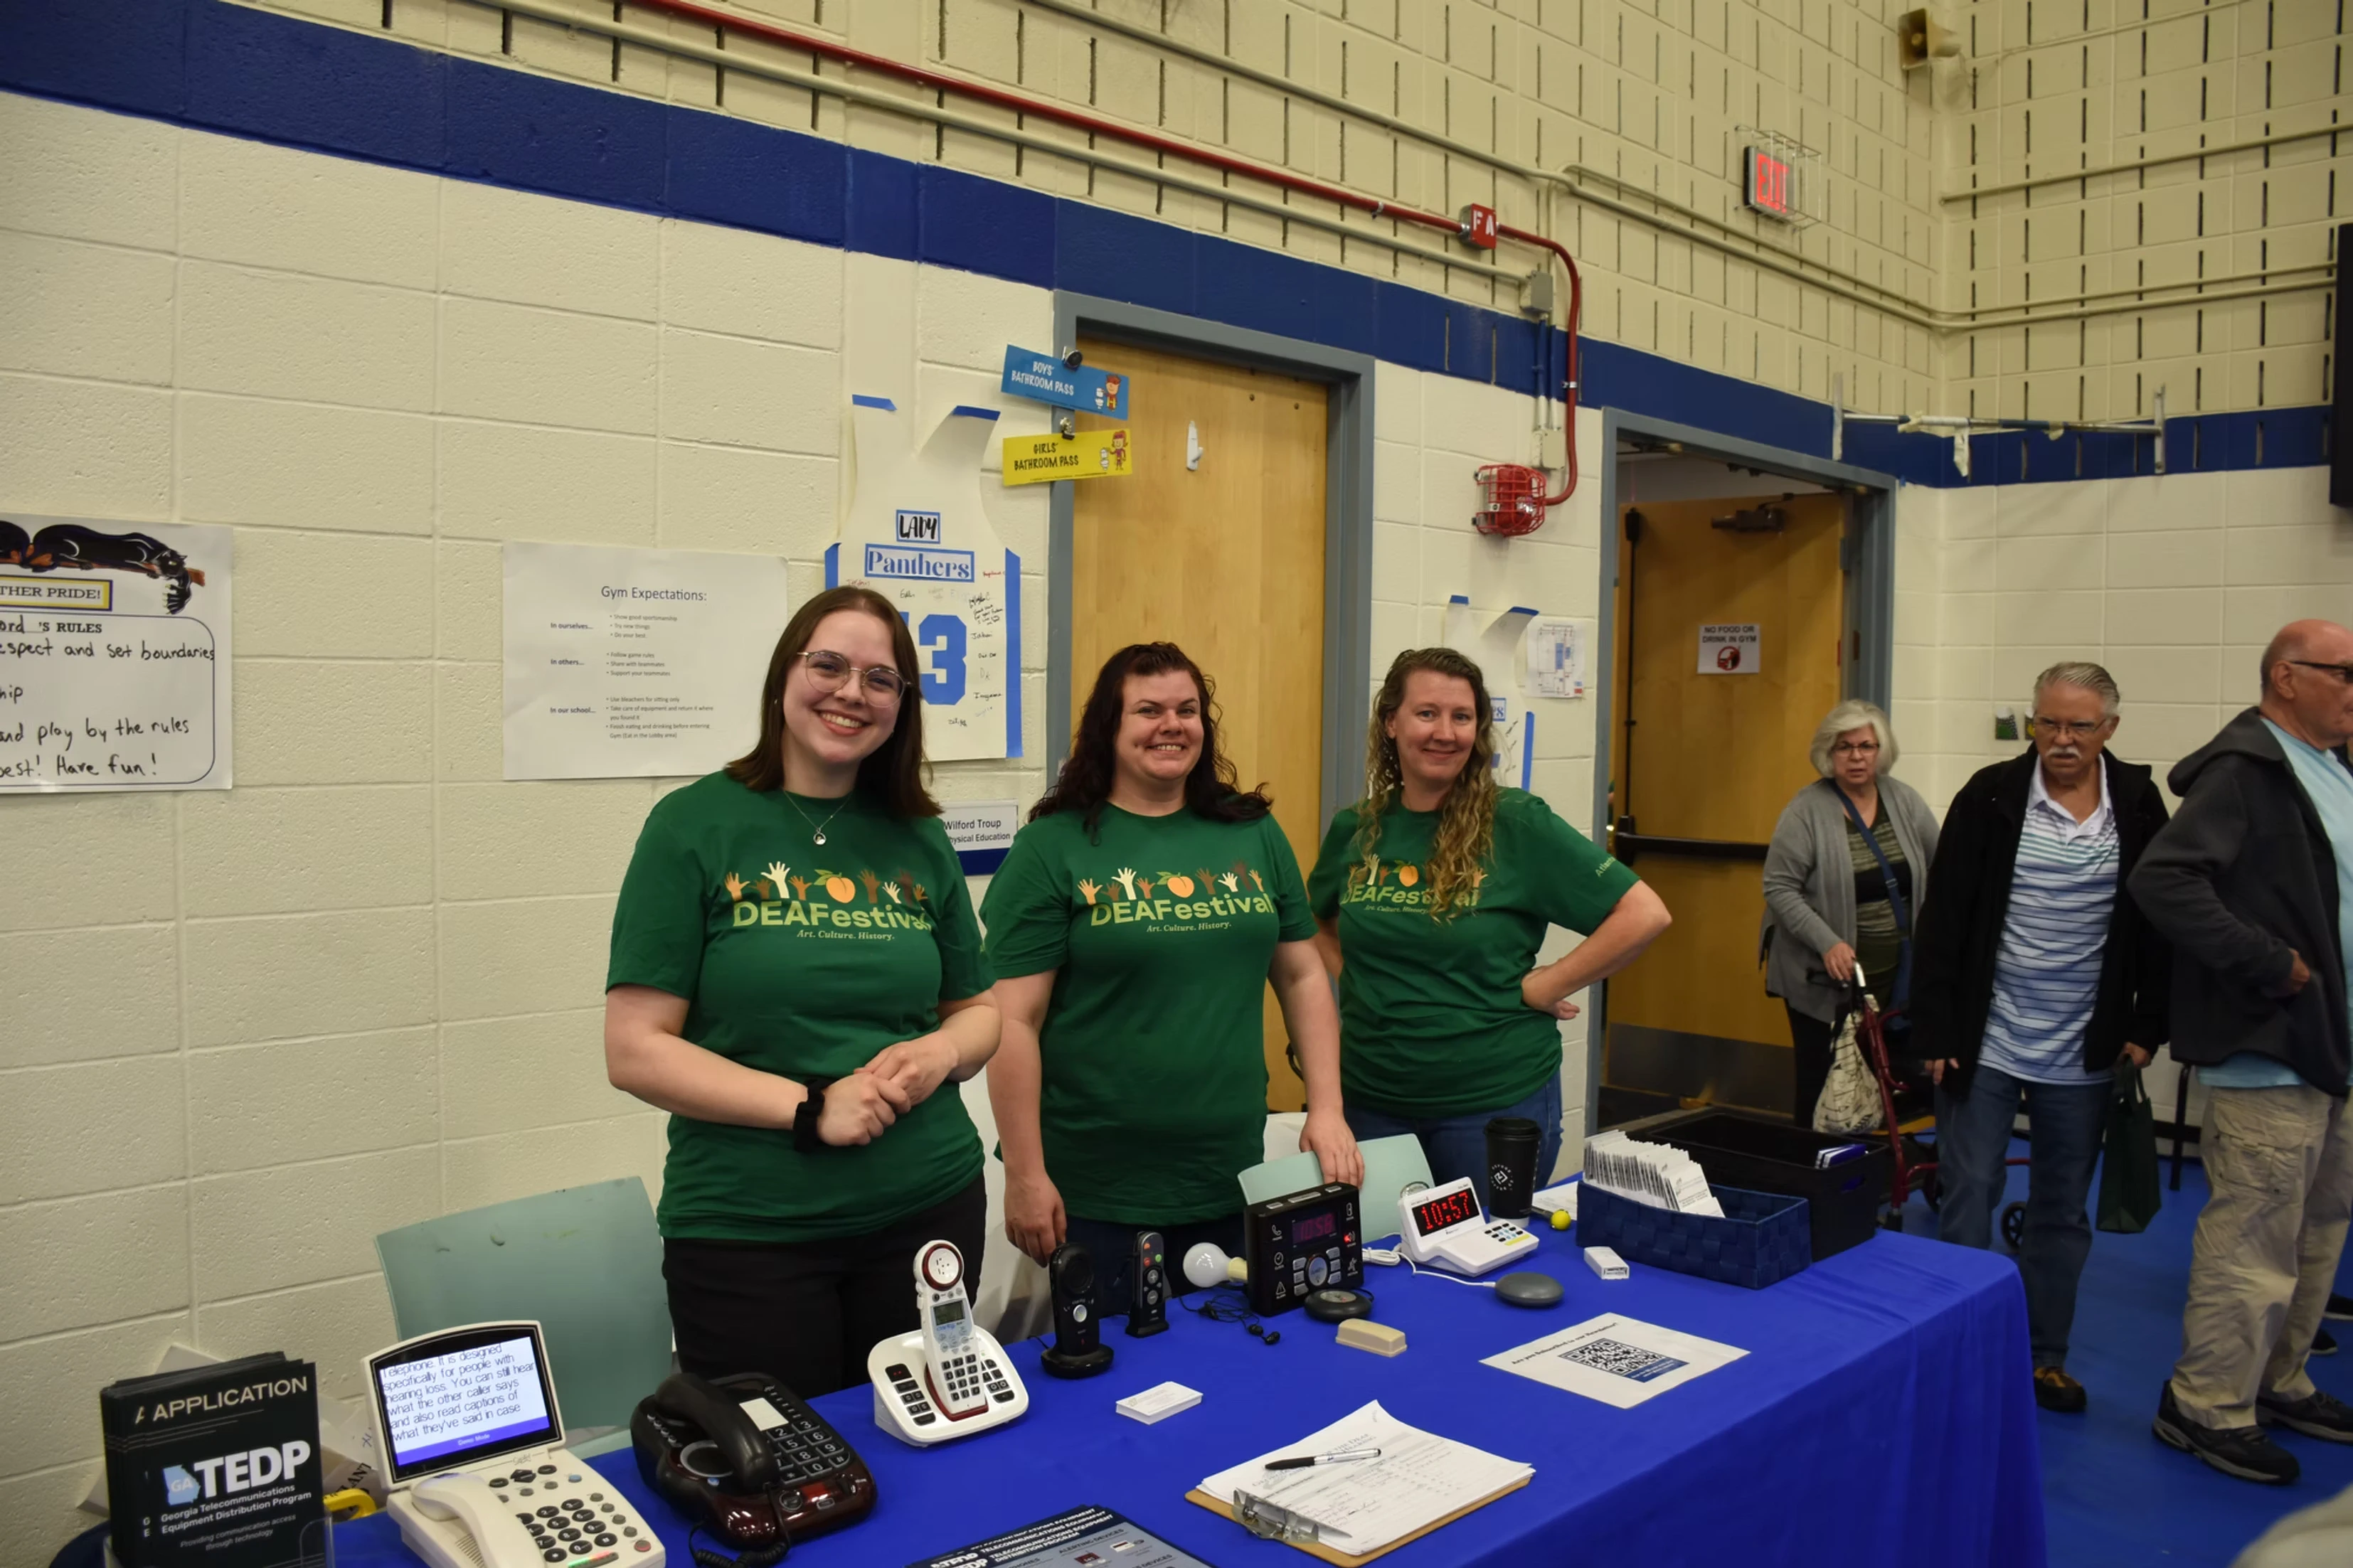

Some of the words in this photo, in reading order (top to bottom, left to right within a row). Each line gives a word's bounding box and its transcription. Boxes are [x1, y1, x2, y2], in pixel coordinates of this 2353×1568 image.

[1011, 370, 1053, 391] BATHROOM
[1055, 380, 1074, 396] PASS
[1014, 457, 1058, 471] BATHROOM
[1060, 455, 1079, 466] PASS
[899, 514, 937, 540] LADY
[869, 550, 970, 578] Panthers
[47, 587, 101, 599] PRIDE!
[601, 586, 628, 599] Gym
[632, 587, 707, 601] Expectations:
[56, 622, 102, 634] RULES
[65, 641, 95, 657] and
[142, 641, 215, 661] boundaries
[38, 722, 73, 751] play
[85, 718, 107, 742] by
[115, 718, 144, 735] the
[152, 718, 189, 733] rules
[57, 754, 100, 776] Have
[977, 819, 1002, 829] Troup
[975, 832, 1010, 842] Education
[1091, 893, 1275, 926] DEAFestival
[797, 929, 816, 938] Art.
[818, 930, 856, 939] Culture.
[858, 932, 895, 942] History.
[1199, 922, 1232, 931] History.
[1421, 1191, 1470, 1230] 10:57
[448, 1355, 456, 1363] is
[460, 1343, 502, 1361] designed
[383, 1371, 436, 1391] specifically
[441, 1368, 455, 1378] for
[459, 1359, 492, 1375] people
[495, 1354, 514, 1365] with
[451, 1377, 472, 1387] You
[475, 1372, 493, 1382] can
[497, 1367, 510, 1378] still
[514, 1362, 534, 1374] hear
[152, 1376, 307, 1422] APPLICATION
[388, 1403, 414, 1416] what
[418, 1398, 433, 1409] the
[437, 1392, 462, 1405] other
[467, 1386, 491, 1398] caller
[496, 1378, 519, 1390] says
[391, 1417, 410, 1429] and
[413, 1412, 435, 1424] also
[437, 1404, 461, 1417] read
[464, 1394, 504, 1412] captions
[508, 1390, 518, 1400] of
[394, 1428, 419, 1441] what
[423, 1419, 459, 1435] they've
[462, 1412, 482, 1424] said
[486, 1410, 494, 1419] in
[497, 1404, 521, 1417] case
[170, 1477, 193, 1493] GA
[193, 1440, 311, 1498] TEDP
[161, 1508, 198, 1523] Georgia
[200, 1485, 295, 1513] Telecommunications
[161, 1515, 214, 1535] Equipment
[216, 1502, 270, 1520] Distribution
[272, 1493, 312, 1508] Program
[180, 1535, 214, 1548] Providing
[216, 1520, 270, 1540] communication
[271, 1514, 297, 1525] access
[1073, 1514, 1113, 1531] EQUIPMENT
[206, 1538, 234, 1551] through
[235, 1529, 274, 1544] technology
[1044, 1532, 1080, 1547] PROGRAM
[1059, 1538, 1095, 1554] ALERTING
[1094, 1529, 1124, 1542] DEVICES
